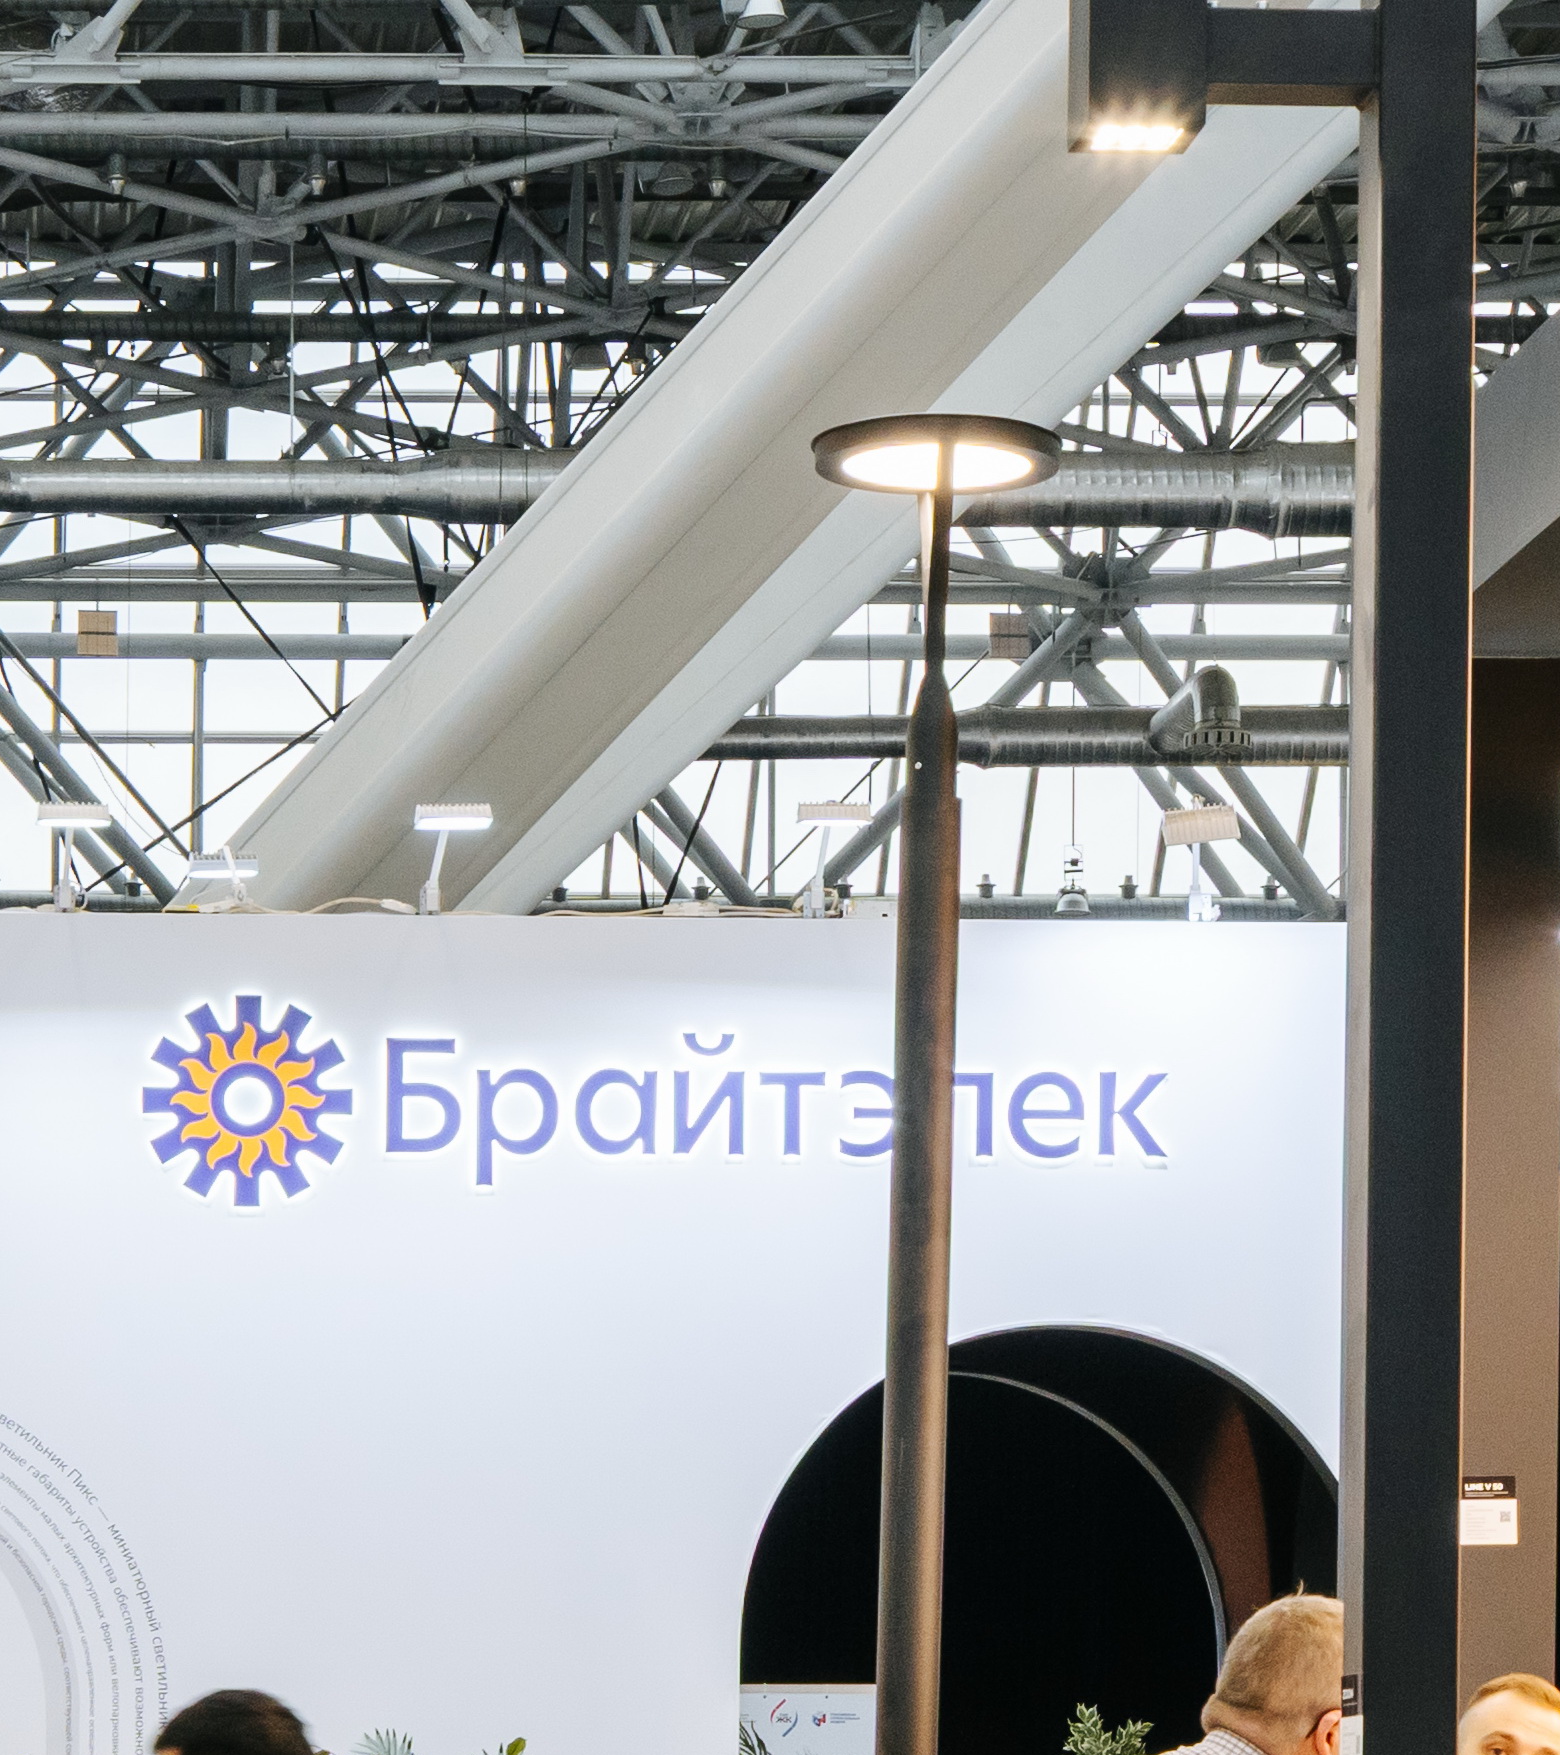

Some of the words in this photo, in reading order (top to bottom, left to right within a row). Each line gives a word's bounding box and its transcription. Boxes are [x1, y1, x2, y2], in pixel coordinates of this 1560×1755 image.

[384, 1030, 1171, 1187] Брайтэлек
[26, 1464, 77, 1517] габариты
[71, 1515, 118, 1584] устройства
[113, 1586, 144, 1683] обеспечивают
[40, 1507, 66, 1543] малых
[63, 1542, 105, 1620] архитектурных
[100, 1621, 114, 1653] форм
[66, 1468, 99, 1506] Пикс
[107, 1523, 163, 1633] миниатюрный
[152, 1635, 169, 1732] светильник
